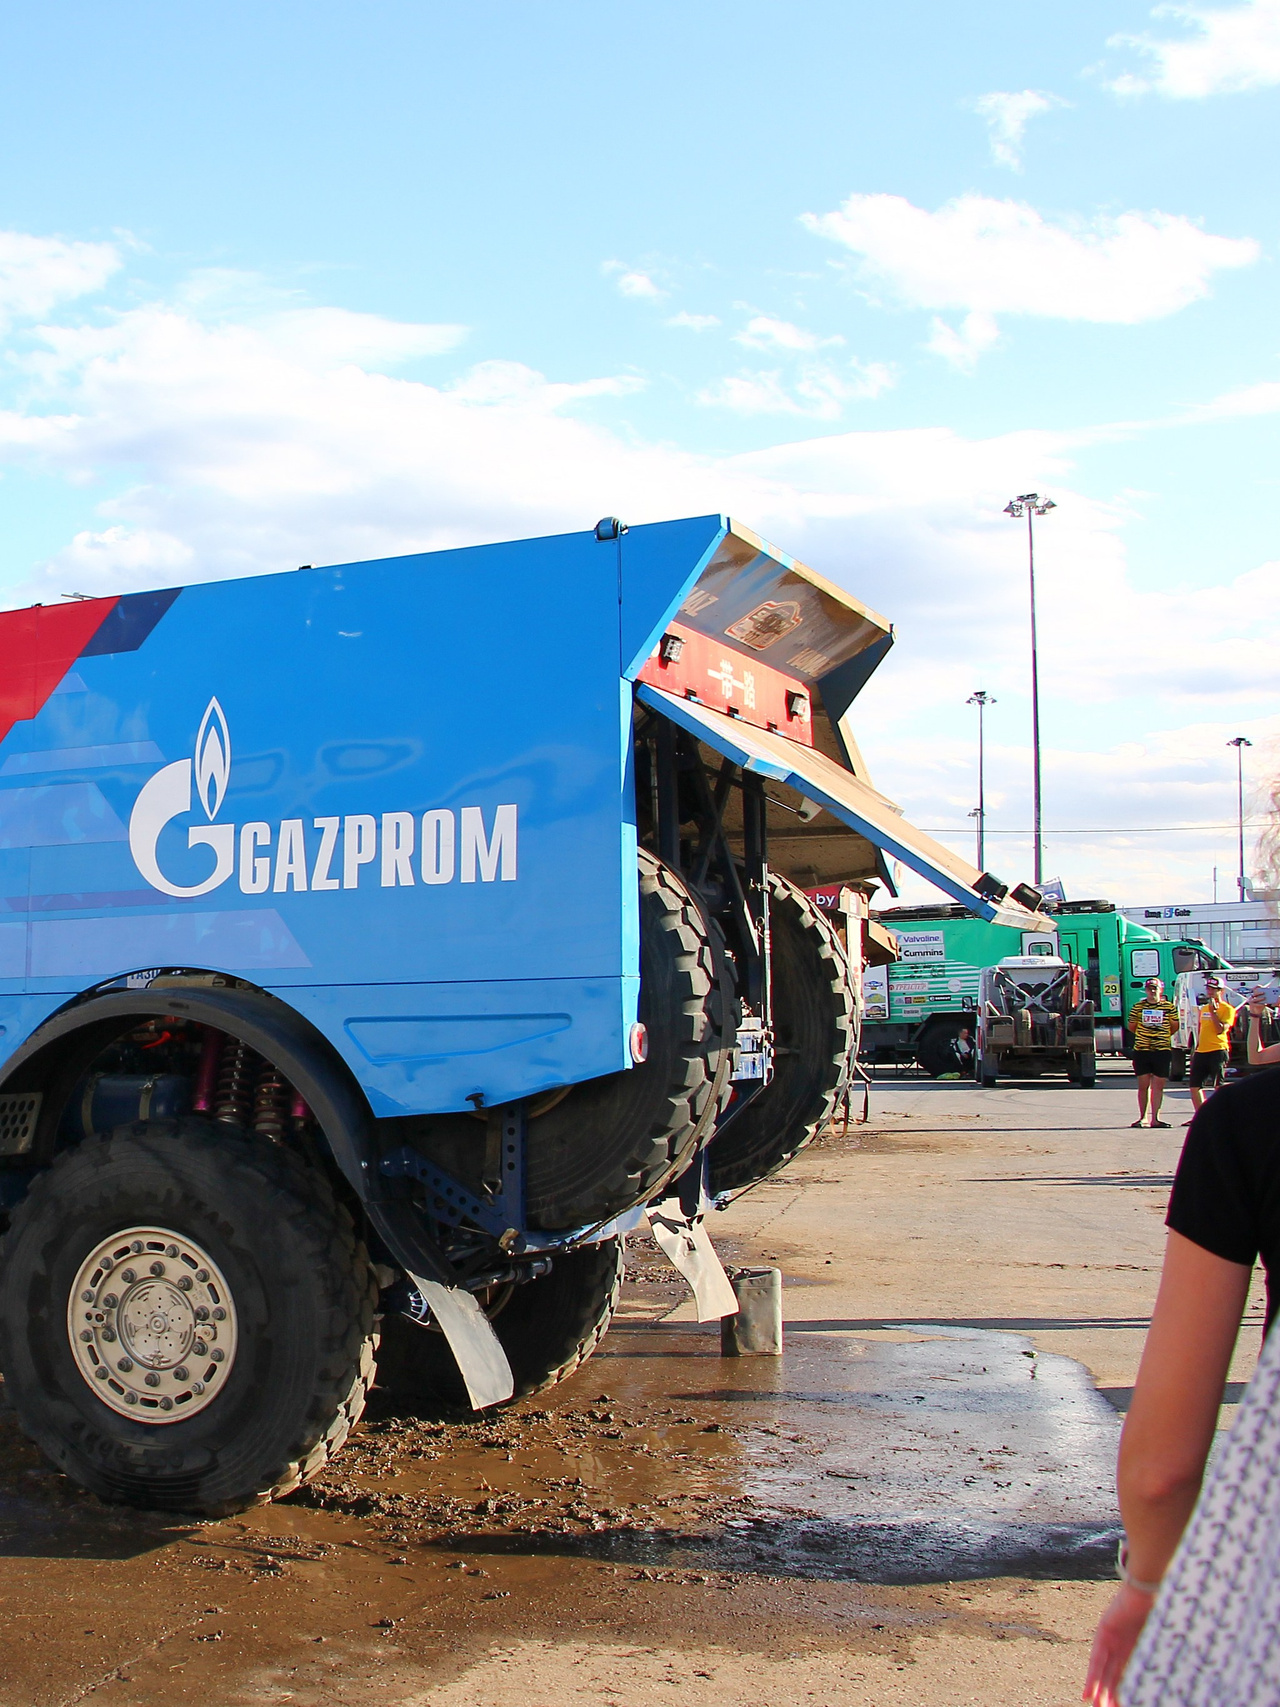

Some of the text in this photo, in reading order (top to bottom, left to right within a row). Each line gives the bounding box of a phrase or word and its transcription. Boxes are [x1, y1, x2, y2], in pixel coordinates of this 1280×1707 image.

[238, 803, 518, 895] GAZPROM
[1174, 908, 1192, 917] Gate
[903, 935, 940, 943] Valvoline
[903, 949, 944, 957] Cummins
[1105, 984, 1118, 994] 29
